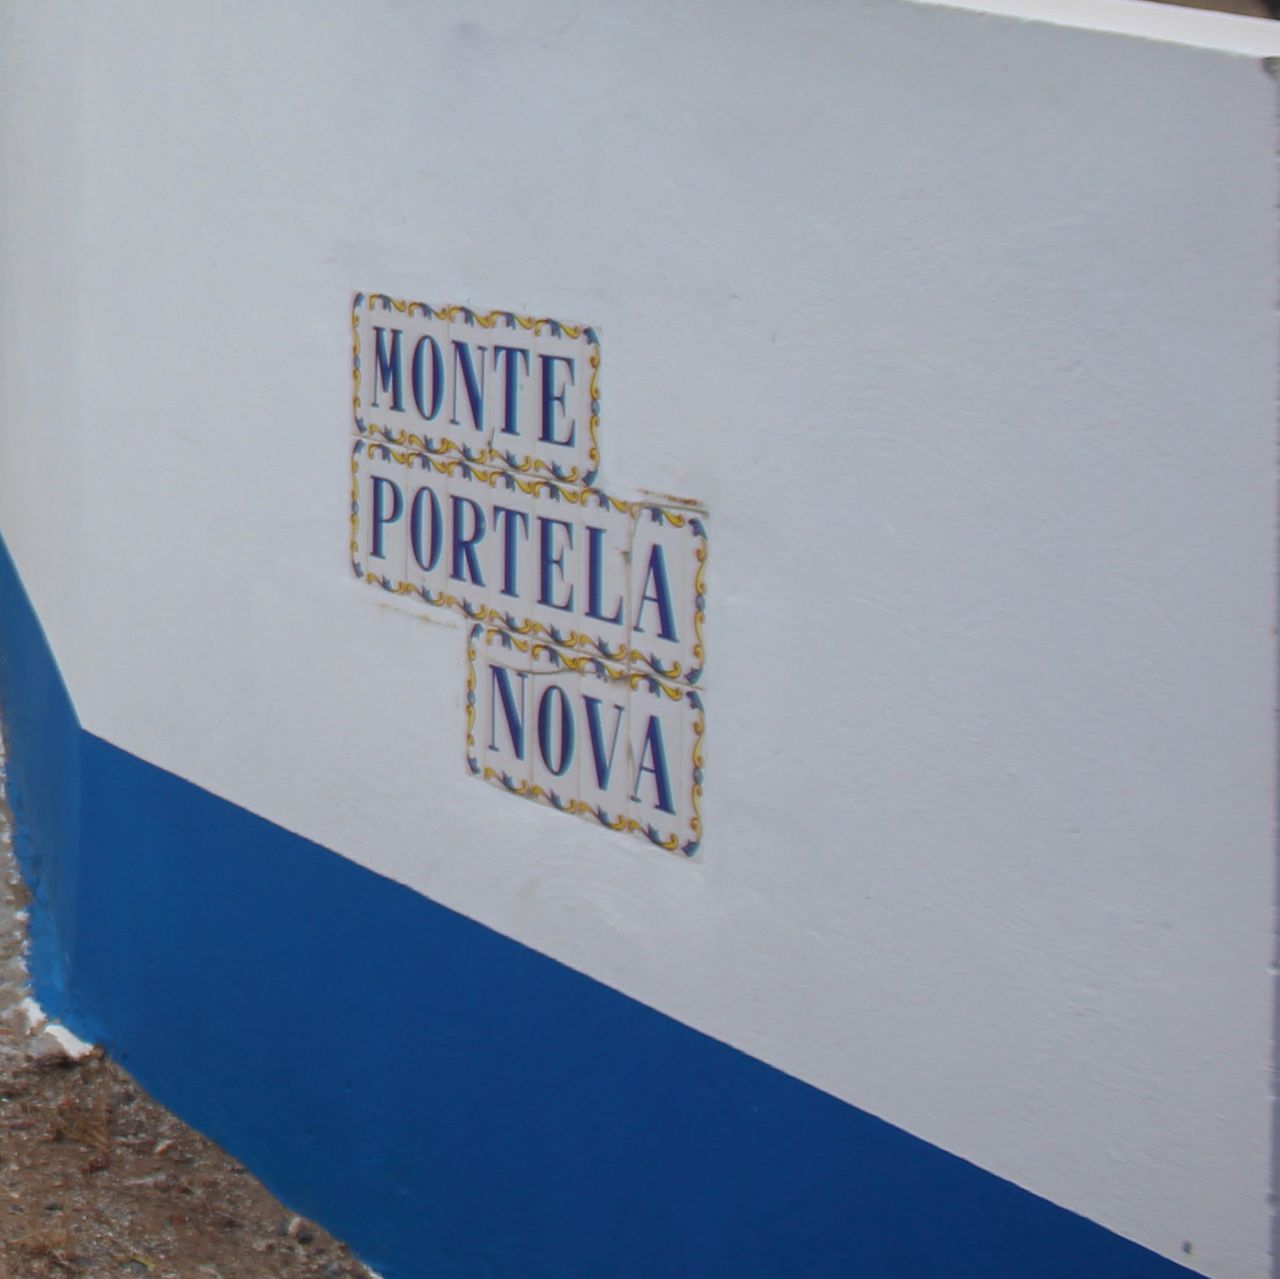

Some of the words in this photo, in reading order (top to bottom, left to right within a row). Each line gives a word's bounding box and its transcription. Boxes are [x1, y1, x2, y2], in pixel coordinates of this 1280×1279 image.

[370, 326, 576, 447] MONTE
[369, 475, 679, 644] PORTELA
[488, 665, 676, 815] NOVA
